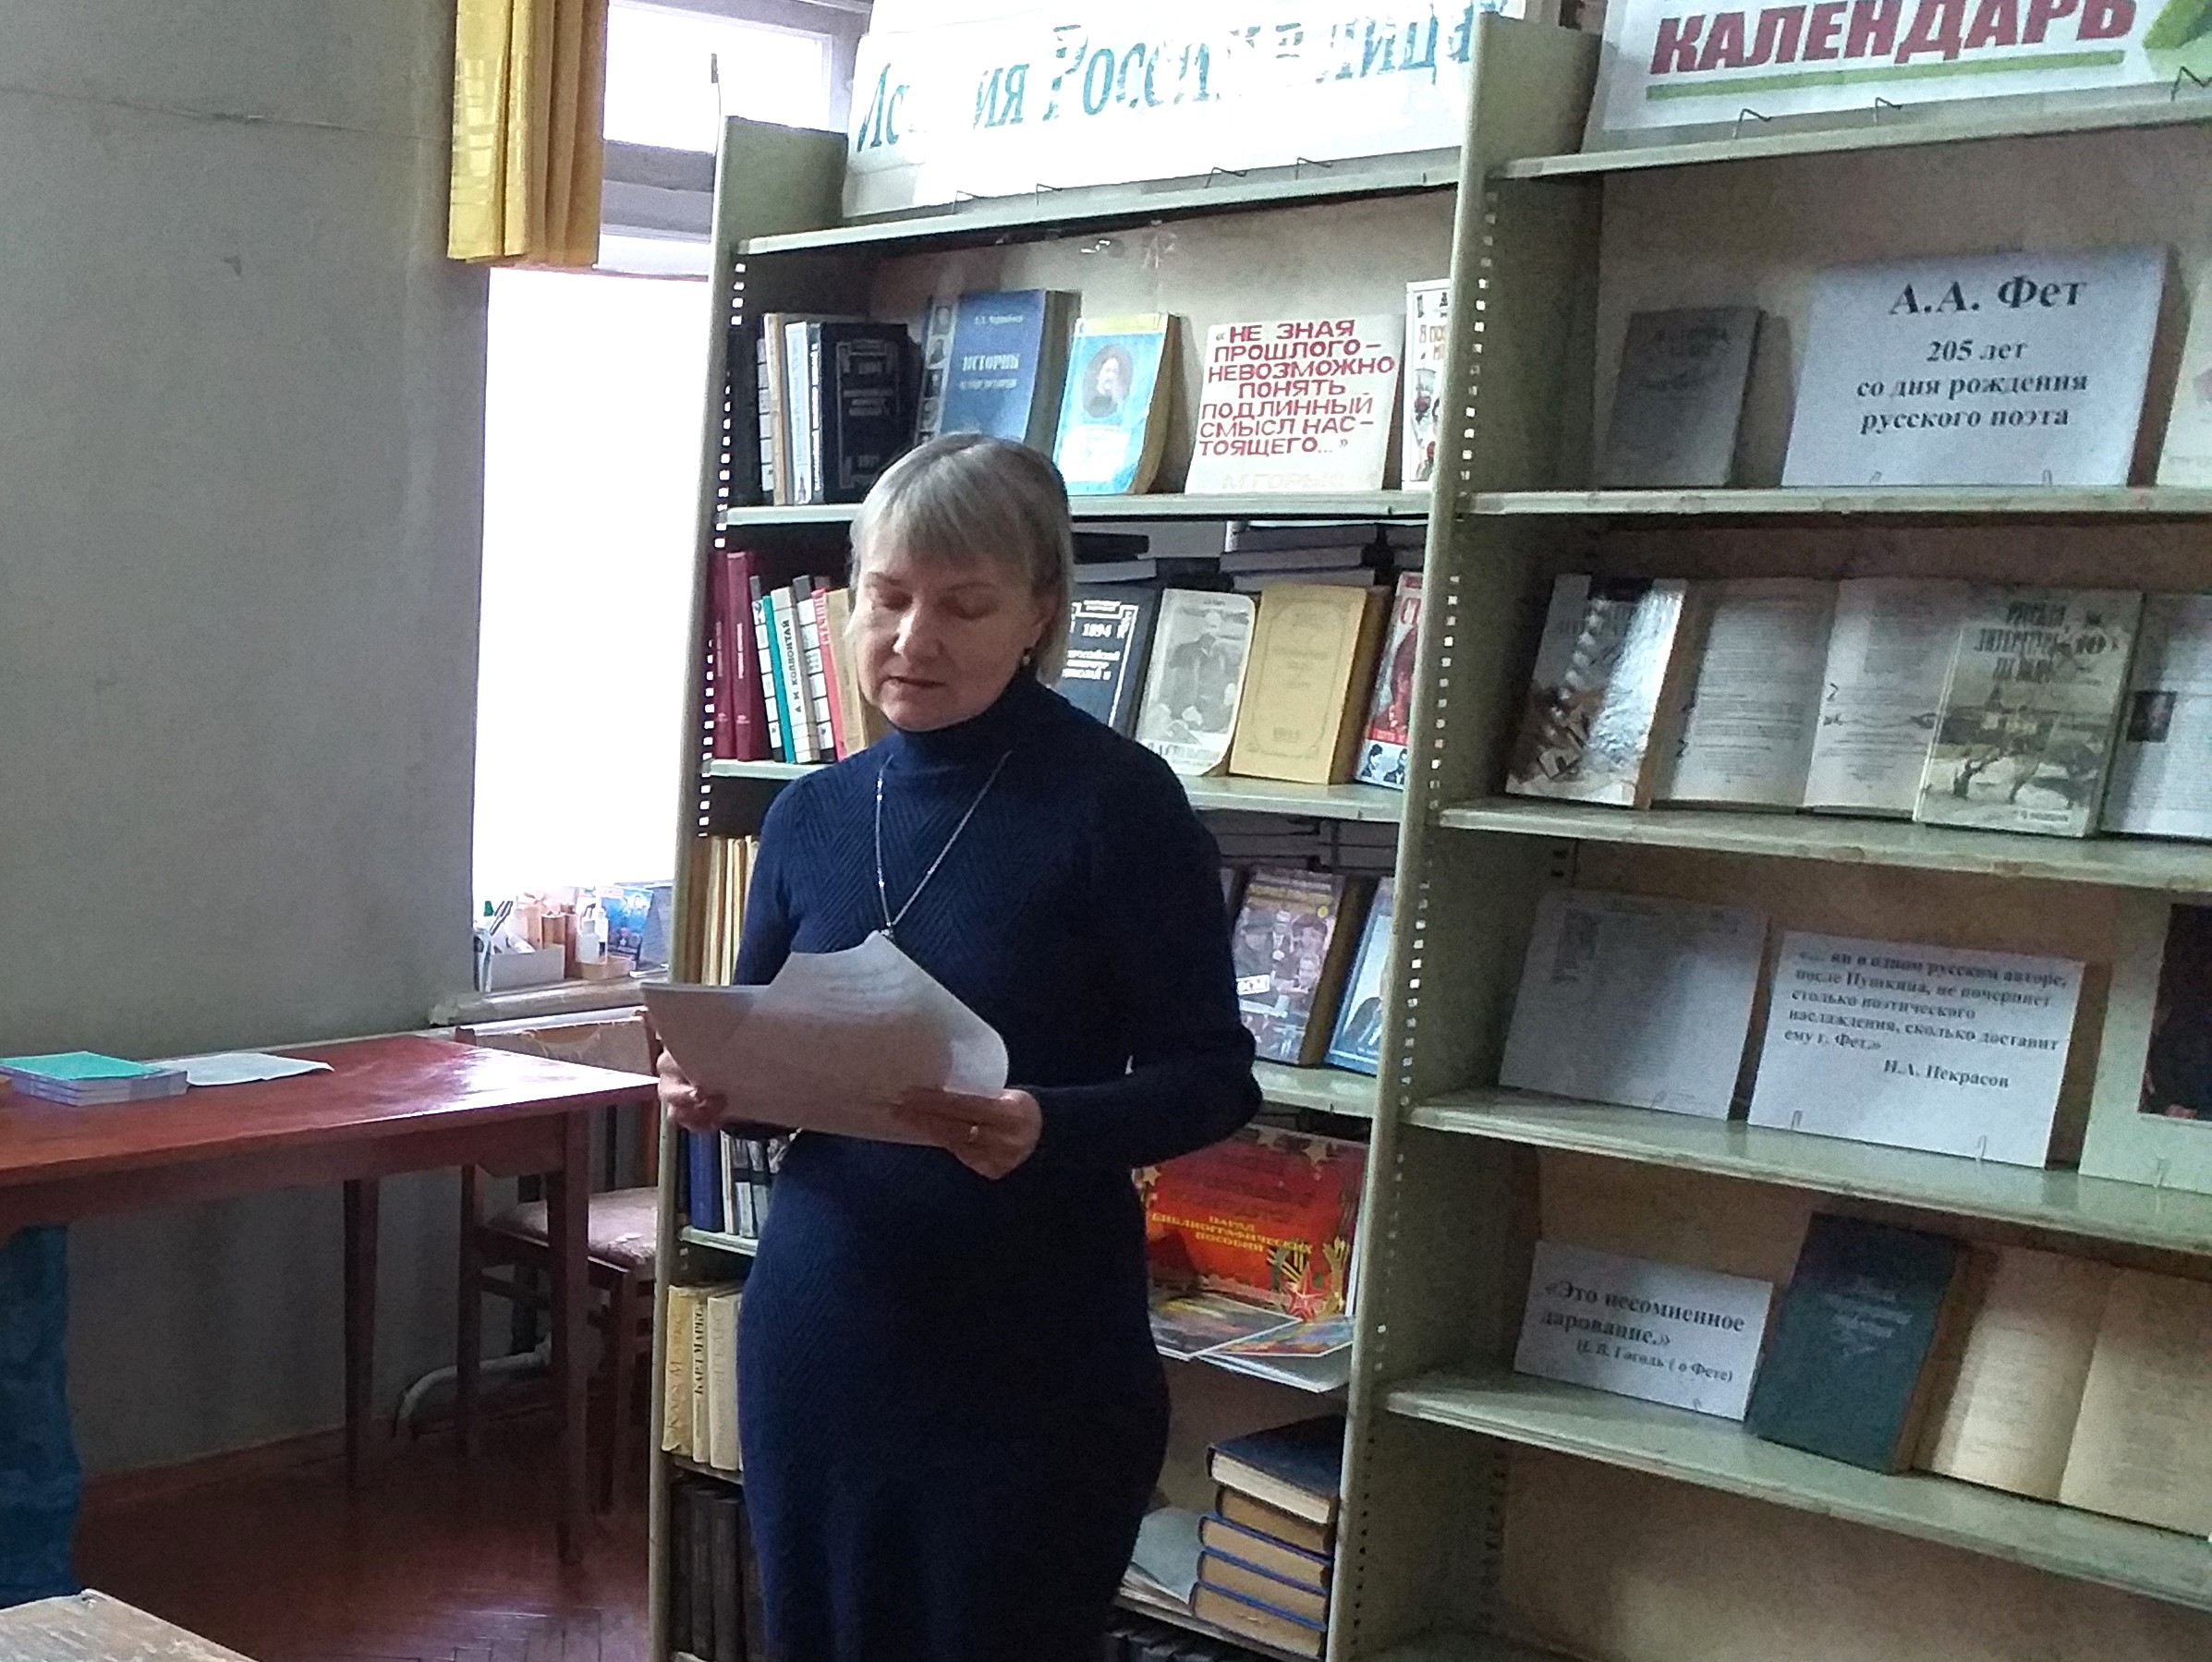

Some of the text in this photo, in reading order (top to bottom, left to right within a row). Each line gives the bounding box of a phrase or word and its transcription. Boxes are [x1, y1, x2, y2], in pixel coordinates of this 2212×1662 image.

[1649, 0, 2136, 75] КАЛЕНДАРЬ
[1888, 274, 2087, 315] А.А. Фет
[1275, 320, 1356, 340] ЗНАЯ
[1926, 339, 2028, 363] 205 лет
[1208, 356, 1396, 383] НЕВОЗМОЖНО
[1238, 379, 1346, 399] ПОНЯТЬ
[1855, 370, 2088, 403] со дня рождения
[1201, 392, 1374, 421] ПОДЛИННЫЙ
[1199, 418, 1295, 439] СМЫСЛ
[1859, 407, 2070, 435] русского поэта
[781, 619, 798, 685] КОЛЛОНТАЙ
[1795, 969, 1841, 985] после
[1846, 971, 1930, 996] Пушкина,
[1936, 984, 1955, 997] не
[1926, 961, 1999, 982] русском
[1792, 989, 1976, 1020] столько поэтического
[1784, 1030, 1813, 1045] ему
[1789, 1009, 2060, 1051] наслаждения, сколько доставит
[1926, 1064, 2010, 1089] Некрасов
[1545, 1280, 1745, 1332] «Это несомненное
[1616, 1344, 1664, 1368] Гоголь
